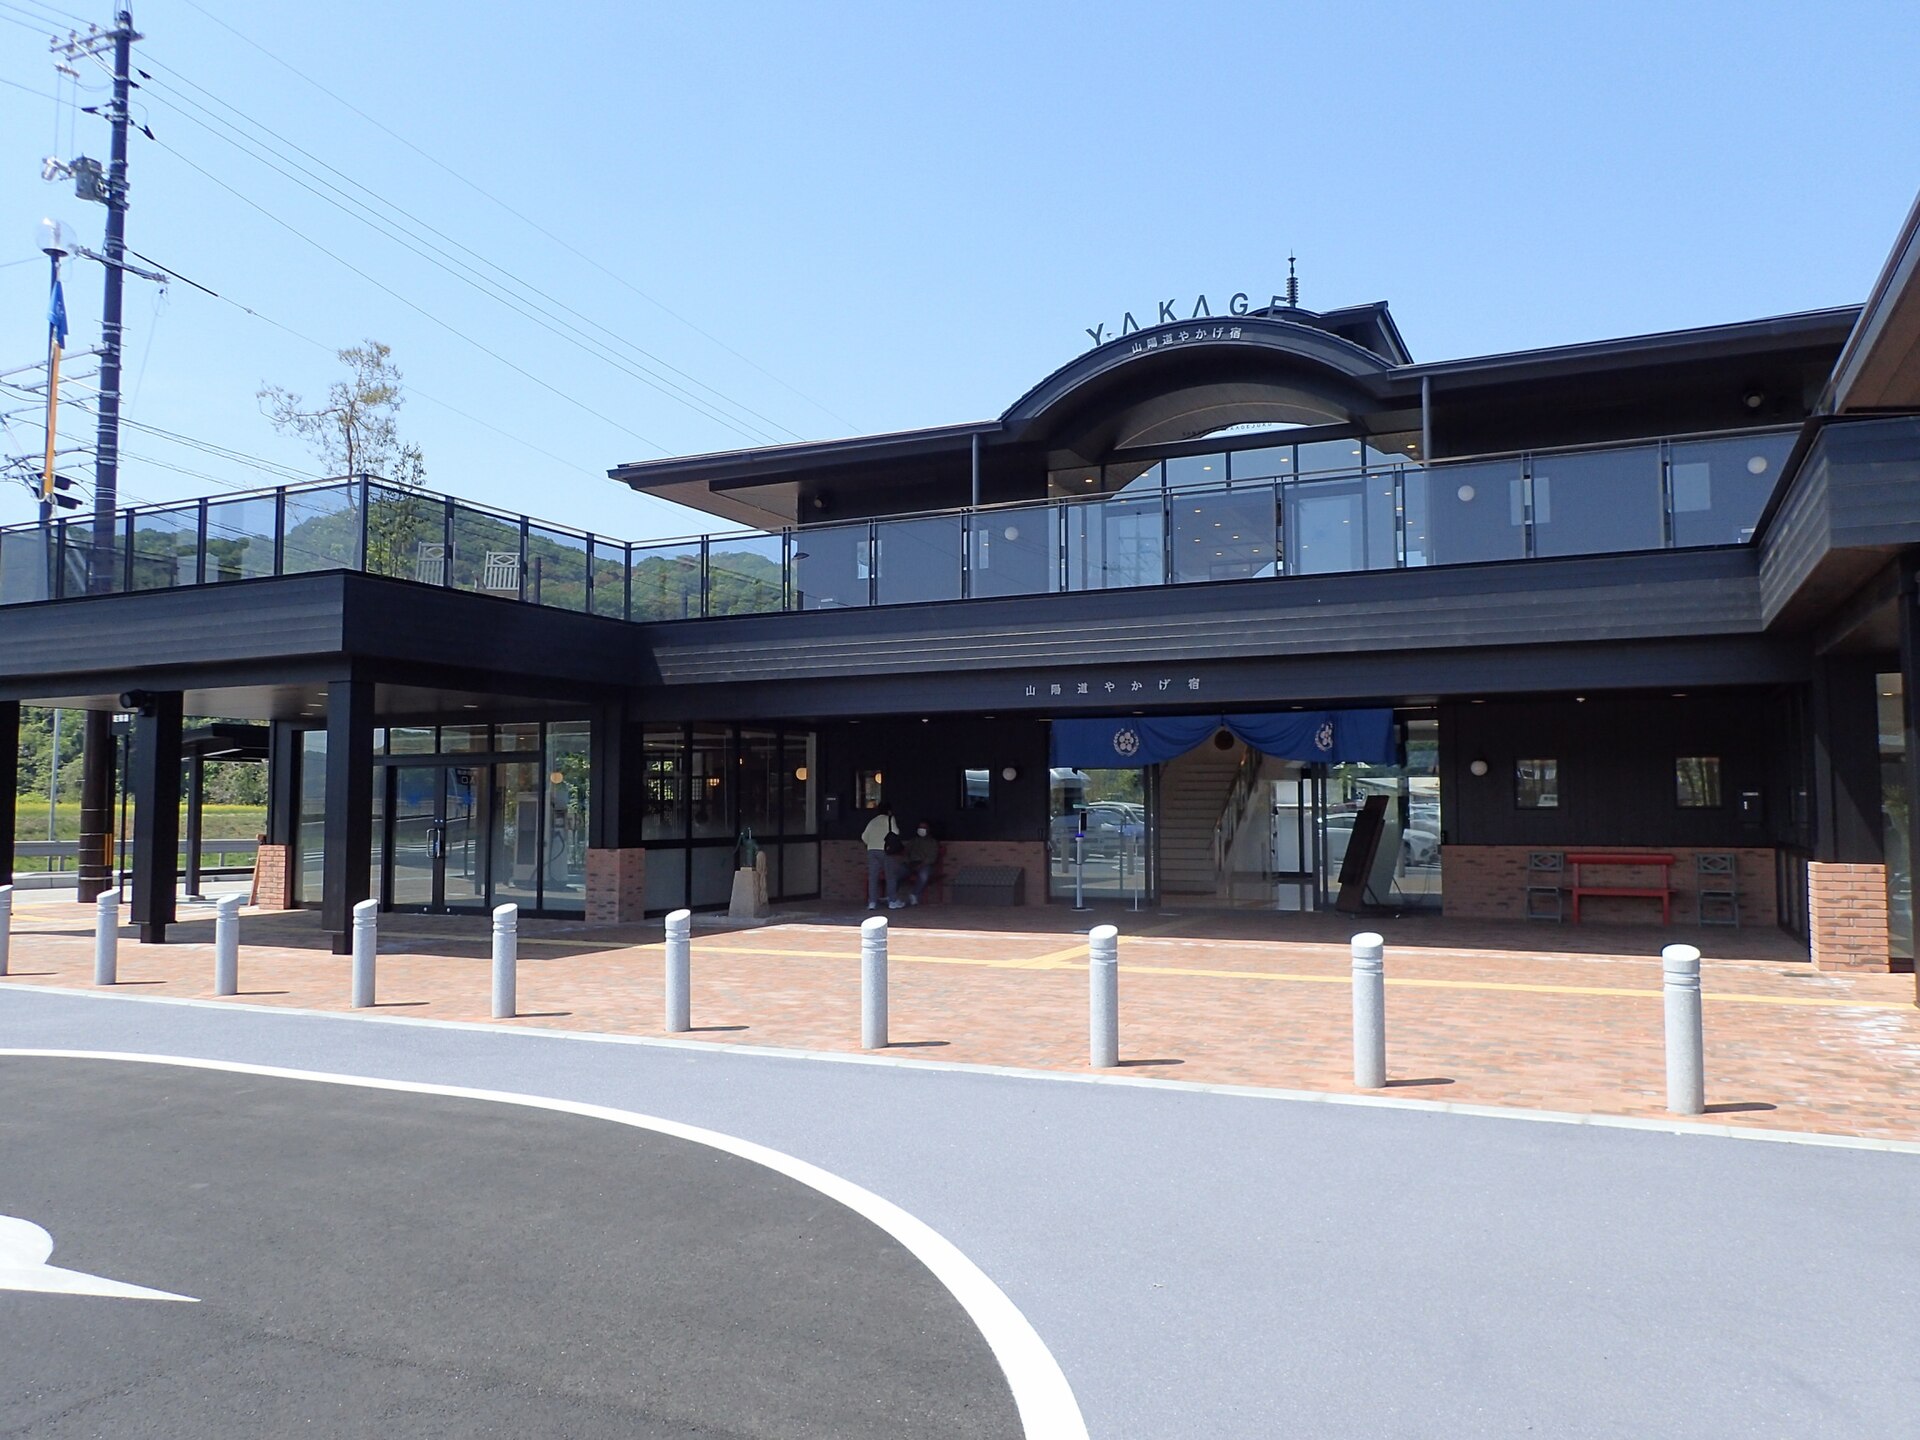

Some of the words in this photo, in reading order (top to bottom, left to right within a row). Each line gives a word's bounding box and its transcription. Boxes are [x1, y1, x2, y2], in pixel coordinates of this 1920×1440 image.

[1132, 327, 1242, 354] 山陽道やかげ宿
[1025, 678, 1200, 696] 山陽道やかげ宿
